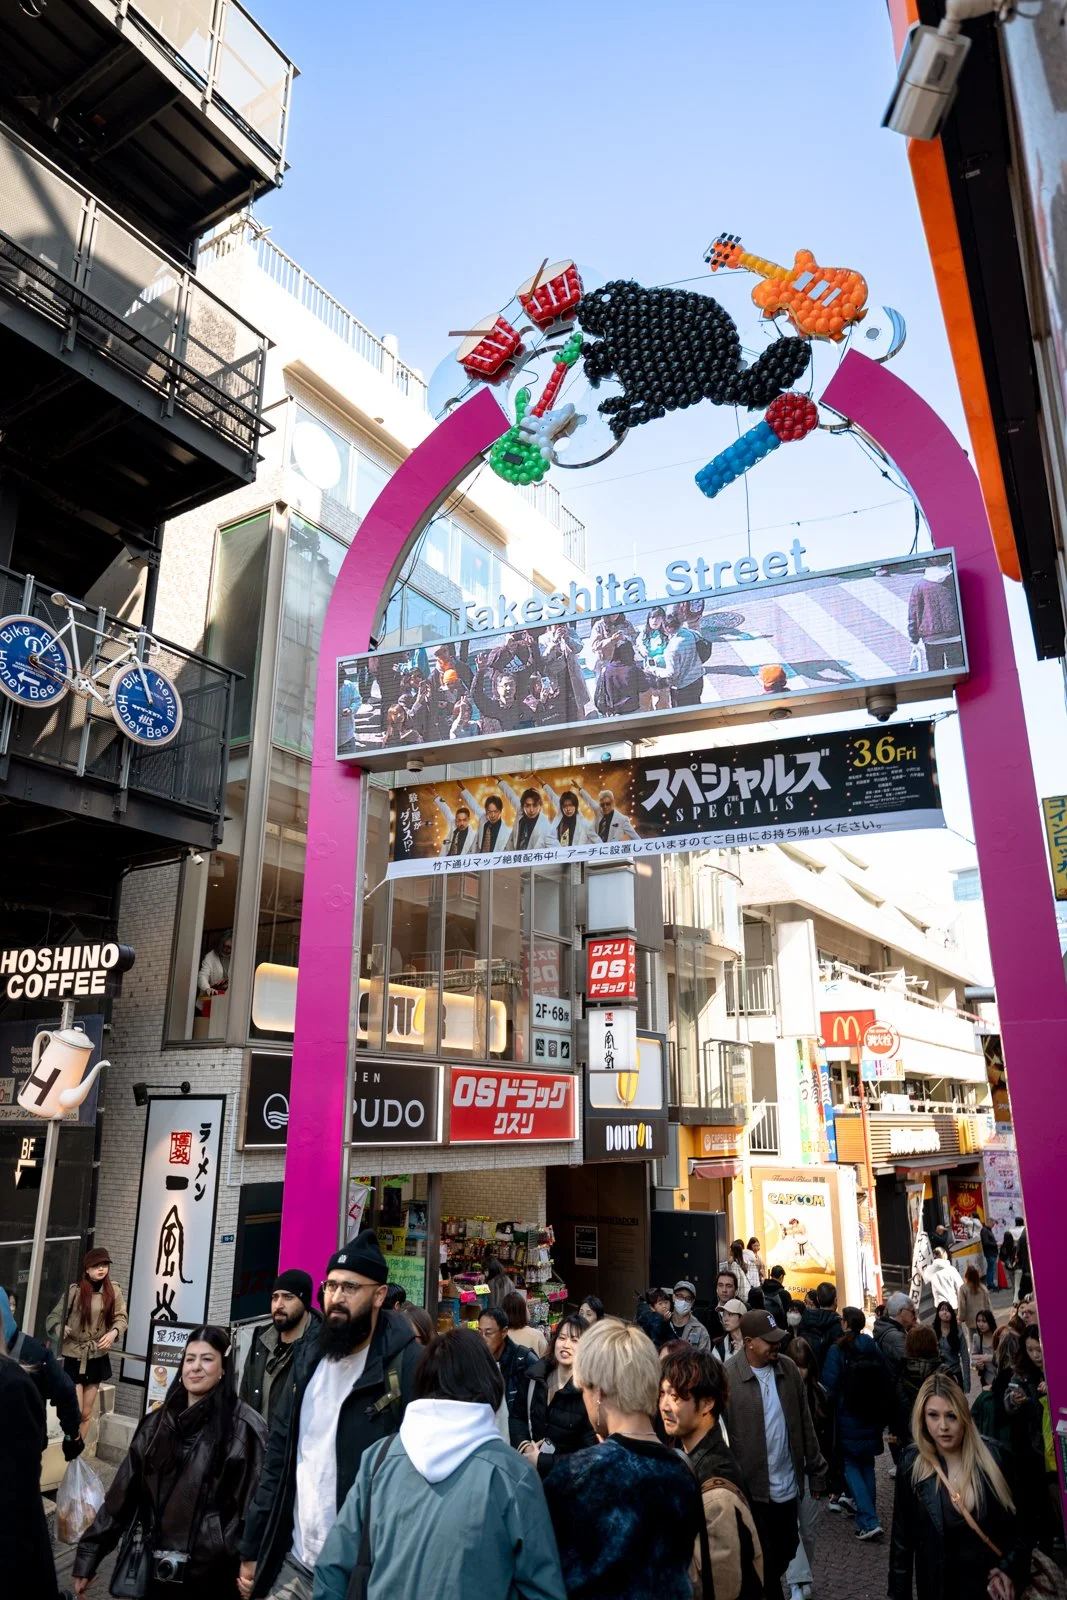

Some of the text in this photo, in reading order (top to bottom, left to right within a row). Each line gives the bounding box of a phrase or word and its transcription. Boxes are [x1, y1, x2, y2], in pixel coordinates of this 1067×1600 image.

[455, 537, 810, 634] Takeshita Street
[0, 625, 31, 644] Bike
[0, 650, 55, 698] Honey Bee
[156, 678, 175, 723] Rental
[118, 694, 143, 735] Honey
[146, 725, 168, 738] Bee
[853, 735, 917, 767] 3.6 Fri
[641, 748, 832, 812] スペシャルズ
[676, 796, 795, 822] SPECIALS
[1, 942, 120, 974] HOSHINO
[592, 944, 625, 957] クスリ
[590, 959, 627, 979] OS
[6, 970, 107, 1000] COFFEE
[590, 982, 628, 994] ドラッグ
[493, 1112, 535, 1135] クスリ
[606, 1122, 652, 1151] DOUTOR
[21, 1138, 36, 1160] BF
[194, 1122, 213, 1203] ラーメン
[768, 1193, 826, 1207] CAPCOM
